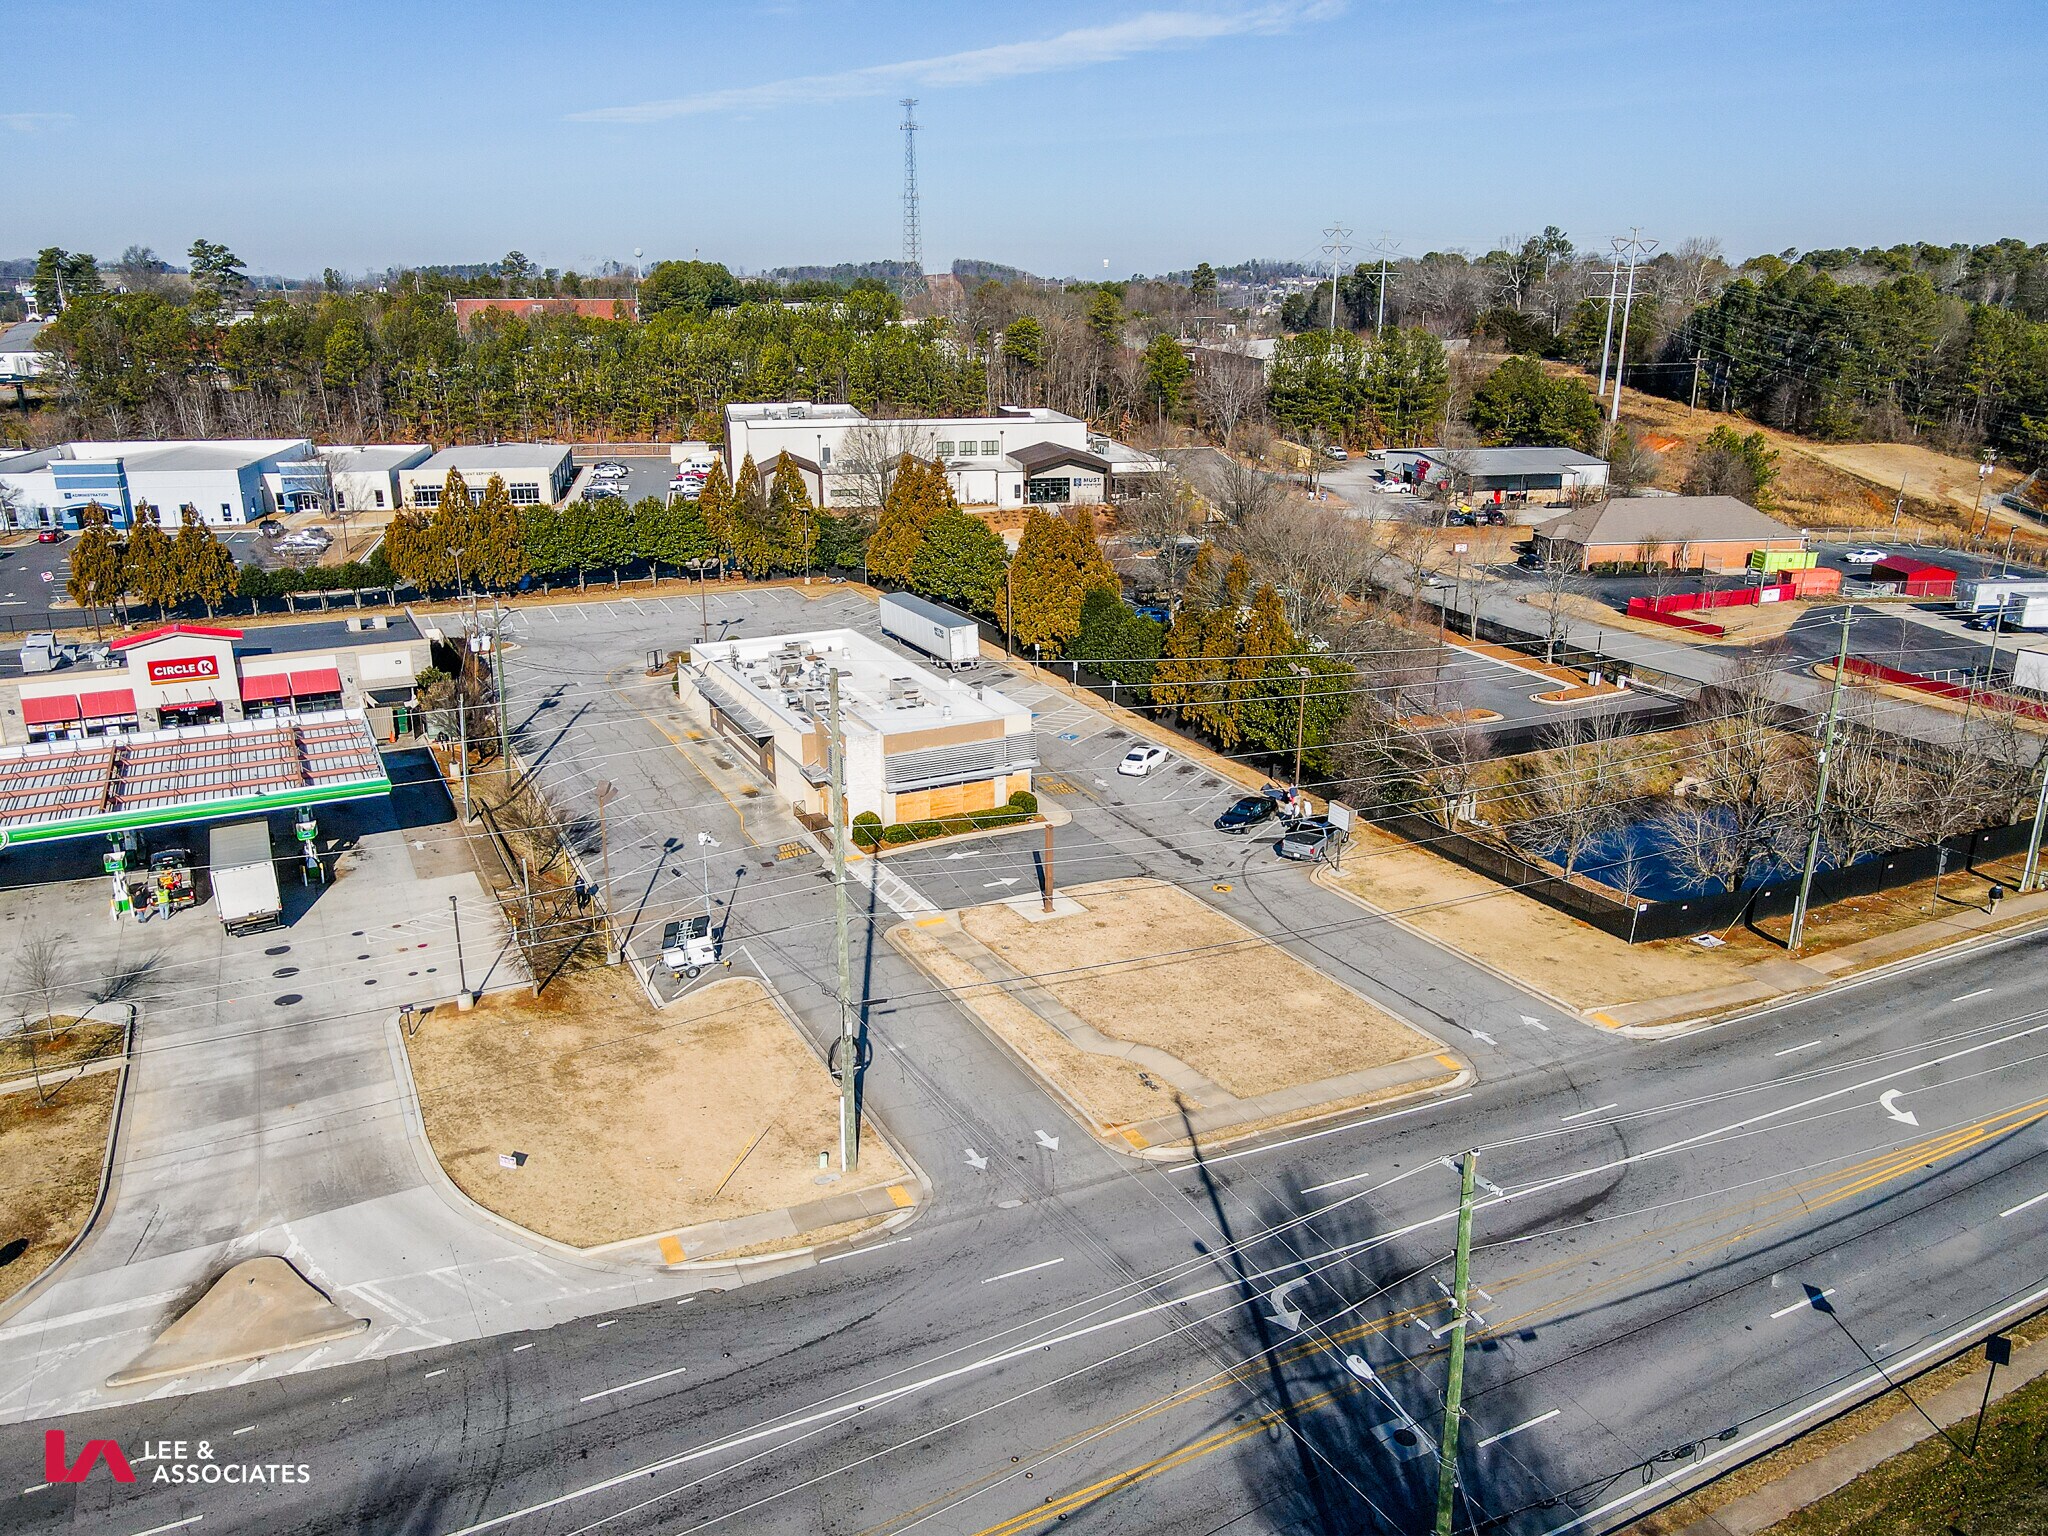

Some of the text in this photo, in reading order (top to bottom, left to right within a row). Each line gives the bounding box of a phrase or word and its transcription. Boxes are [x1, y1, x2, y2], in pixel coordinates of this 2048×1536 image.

[153, 661, 213, 676] CIRCLE K
[775, 846, 813, 861] THANK
